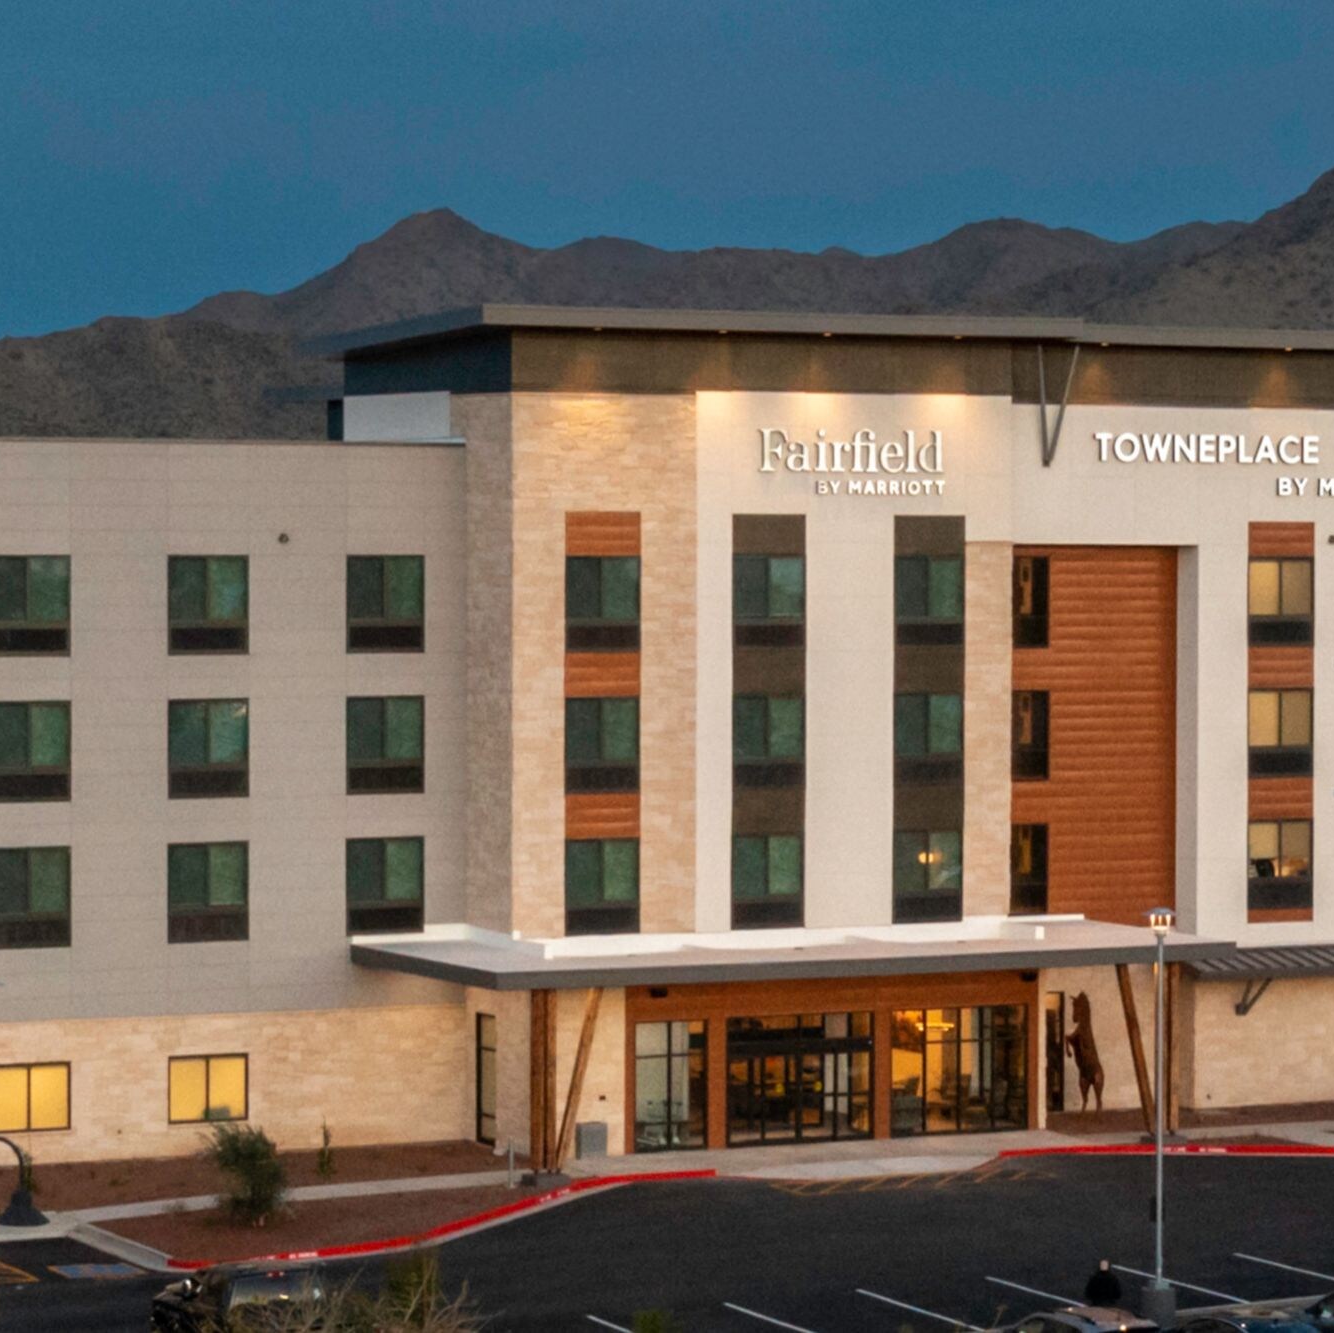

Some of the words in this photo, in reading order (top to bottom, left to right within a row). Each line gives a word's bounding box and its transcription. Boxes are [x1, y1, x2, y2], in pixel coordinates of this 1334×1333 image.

[757, 427, 944, 474] Fairfield
[1094, 432, 1320, 464] TOWNEPLACE
[816, 480, 841, 495] BY
[847, 480, 946, 496] MARRIOTT
[1276, 476, 1308, 497] BY
